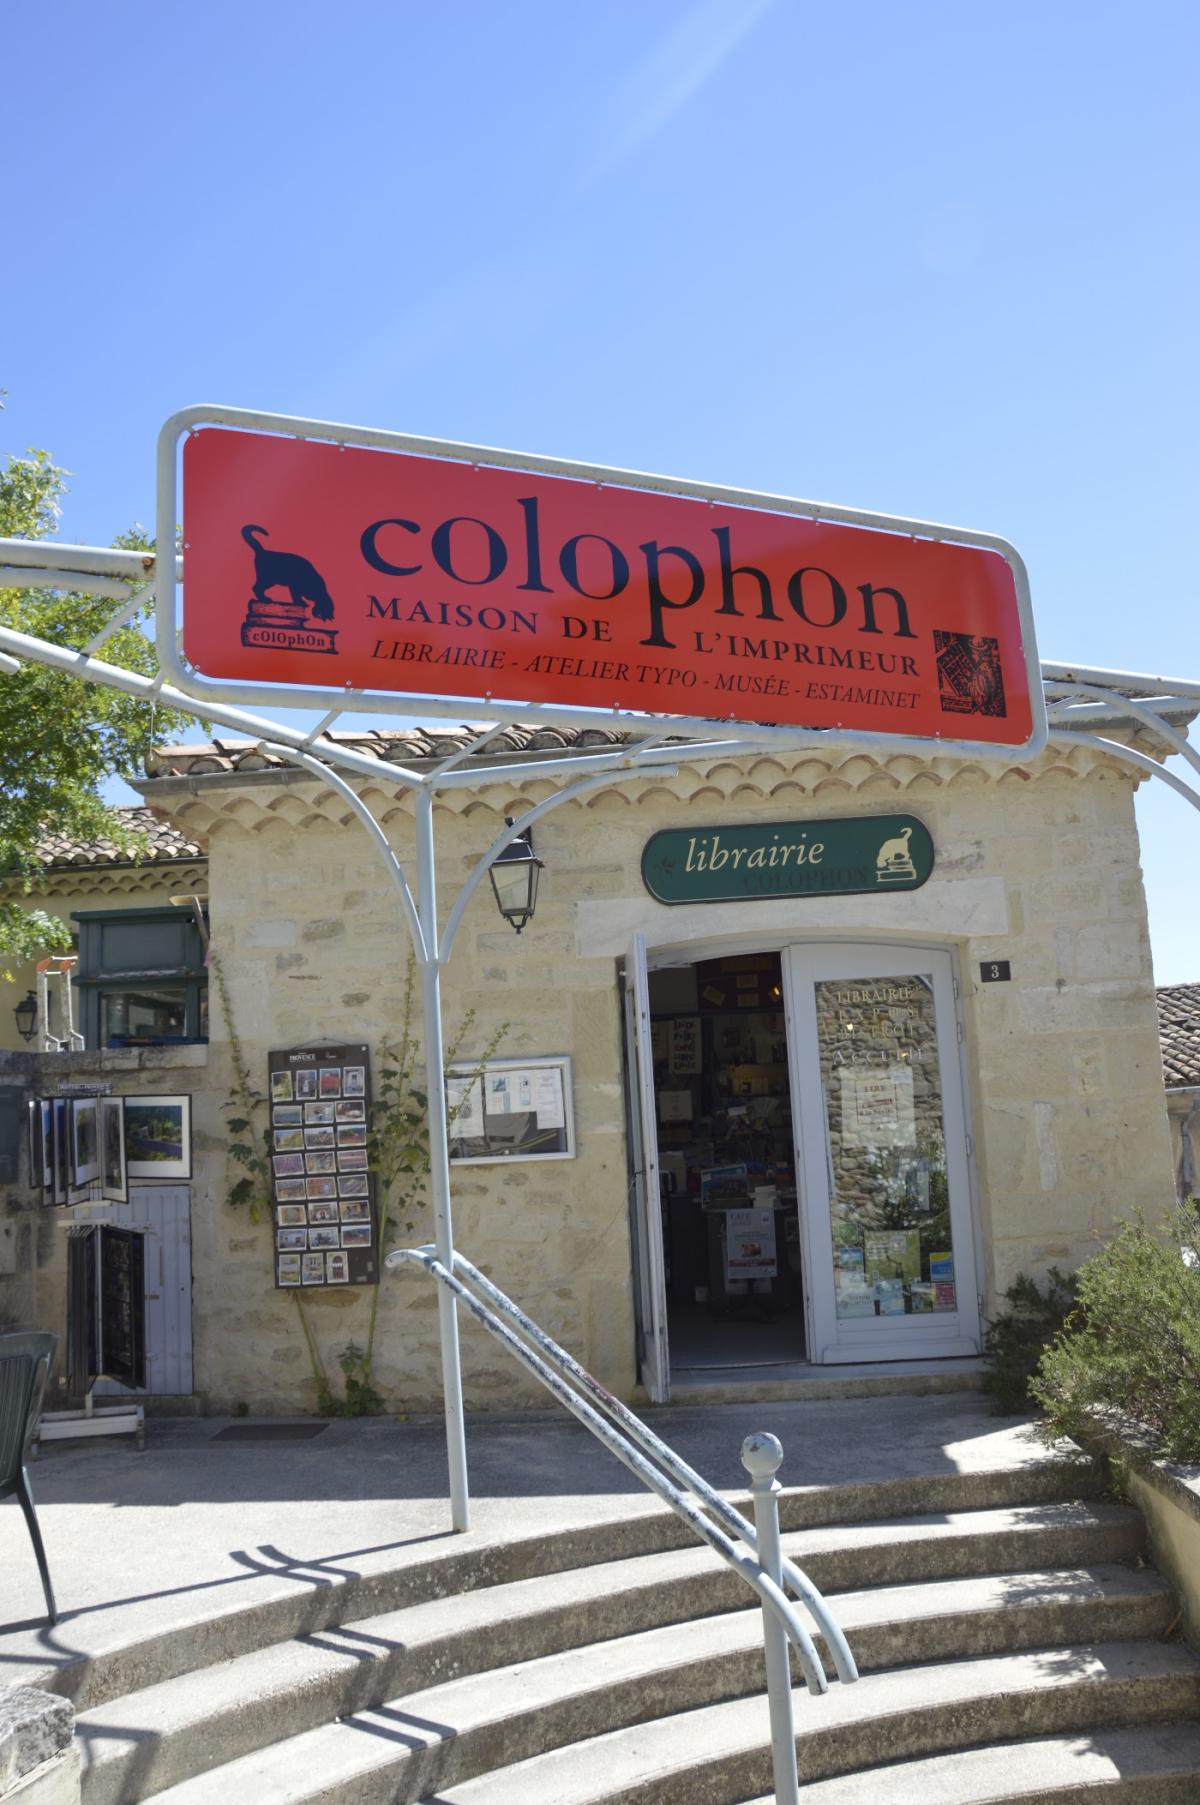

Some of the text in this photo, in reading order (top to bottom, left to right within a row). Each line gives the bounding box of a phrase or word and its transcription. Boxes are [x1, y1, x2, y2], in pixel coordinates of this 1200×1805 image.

[367, 595, 920, 677] MAISON DE L'IMPRIMEUR
[370, 640, 507, 670] LIBRAIRIE
[524, 653, 629, 683] ATELIER
[637, 666, 698, 689] TYPO
[714, 673, 790, 698] MUSÉE
[806, 683, 920, 710] ESTAMINET
[684, 833, 825, 872] librairie
[991, 964, 1000, 979] 3
[838, 987, 912, 1003] LIBRAIRIE
